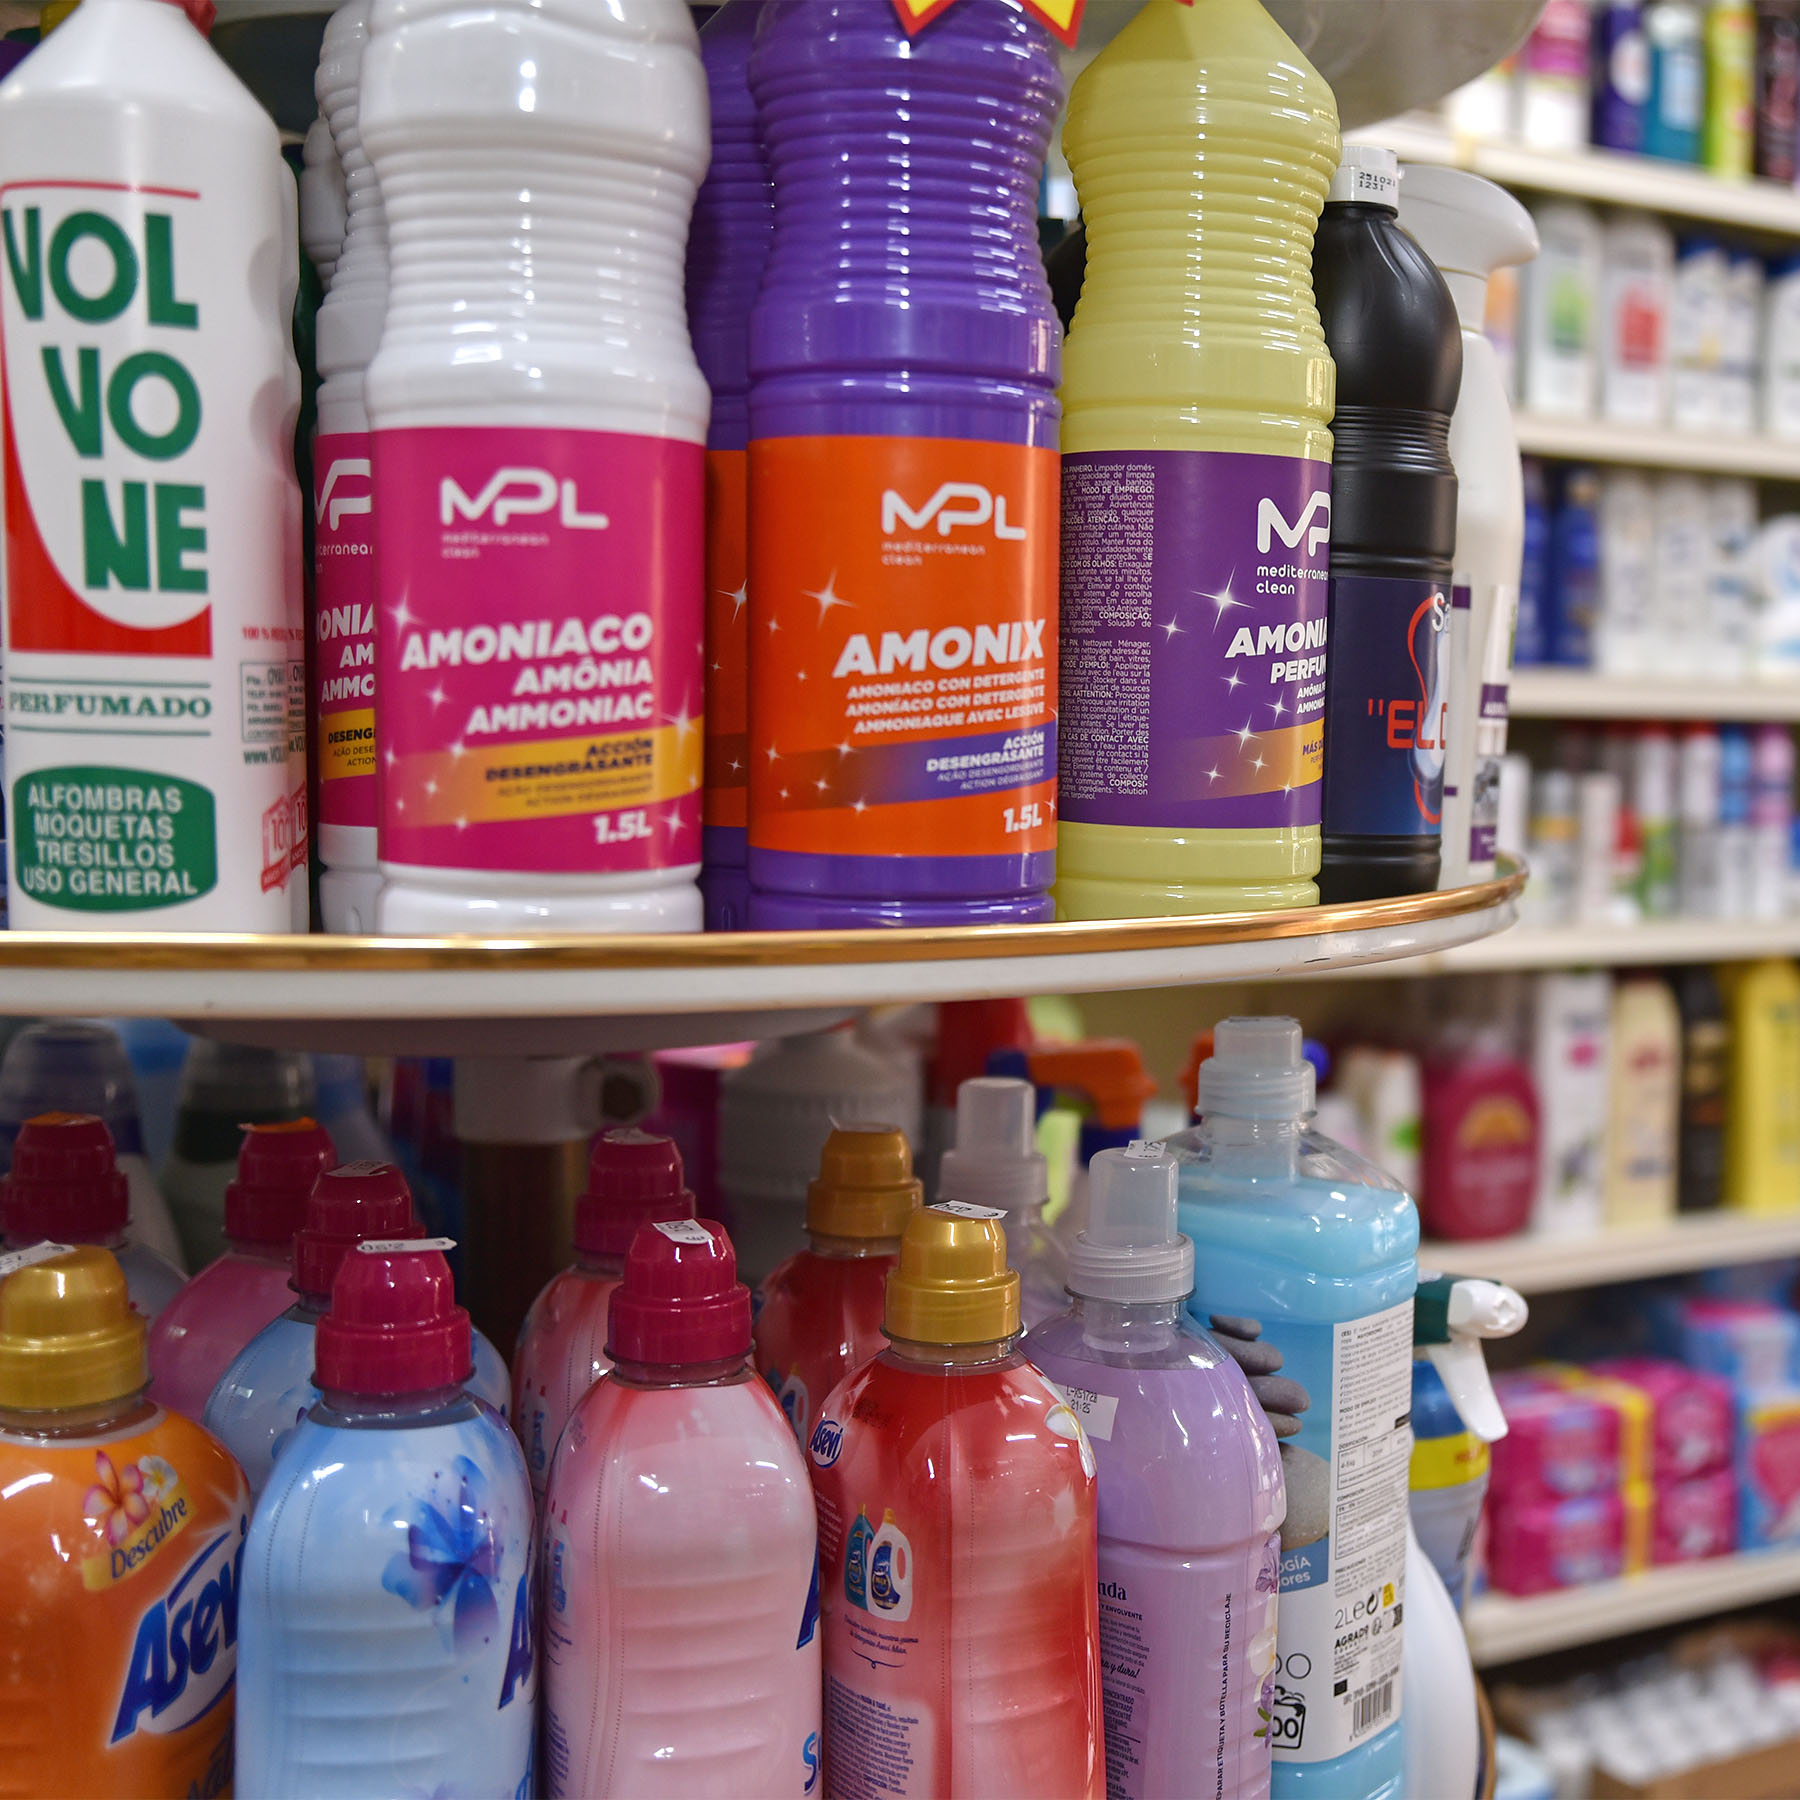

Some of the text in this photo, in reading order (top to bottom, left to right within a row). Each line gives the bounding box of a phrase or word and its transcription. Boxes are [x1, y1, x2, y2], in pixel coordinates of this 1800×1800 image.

[2, 206, 199, 329] VOL
[41, 347, 202, 462] VO
[440, 466, 609, 530] MPL
[881, 482, 1026, 540] MPL
[1088, 514, 1120, 524] ATENÇÃO:
[81, 478, 208, 593] NE
[882, 540, 985, 556] mediterranean
[882, 553, 922, 566] clean
[1119, 561, 1152, 569] Enxaguar
[1256, 581, 1295, 595] clean
[1099, 611, 1152, 620] COMPOSIÇÃO:
[401, 612, 653, 673] AMONIACO
[832, 617, 1046, 678] AMONIX
[1119, 640, 1151, 648] Ménager.
[513, 657, 653, 696] AMÔNIA
[1093, 676, 1117, 684] Stocker
[1115, 662, 1151, 670] Appliquer
[846, 668, 1045, 699] AMONIACO CON DETERGENTE
[973, 685, 1045, 706] DETERGENTE
[1115, 691, 1150, 700] Provoque
[9, 691, 211, 718] PERFUMADO
[466, 692, 653, 735] AMMONIAC
[853, 702, 1045, 735] AMMONIAQUE AVEC LESSIVE
[1090, 706, 1129, 714] consultation
[1003, 730, 1044, 750] ACCIÓN
[486, 752, 653, 781] DESENGRASANTE
[926, 744, 1044, 772] DESENGRASANTE
[28, 783, 183, 813] ALFOMBRAS
[960, 776, 995, 791] ACTION
[1110, 779, 1148, 788] COMPOSI-
[1118, 787, 1148, 795] Solution
[33, 811, 174, 840] MOQUETAS
[593, 811, 652, 844] 1.5L
[1002, 802, 1042, 833] 1.5L
[35, 840, 175, 869] TRESILLOS
[23, 866, 198, 895] USO GENERAL
[809, 1420, 843, 1459] Asevi
[111, 1498, 187, 1579] Descubre
[1106, 1606, 1143, 1620] ENVOLVENTE
[1223, 1640, 1230, 1653] SU
[1219, 1678, 1228, 1717] BOTELLA
[1217, 1725, 1225, 1766] ETIQUETA
